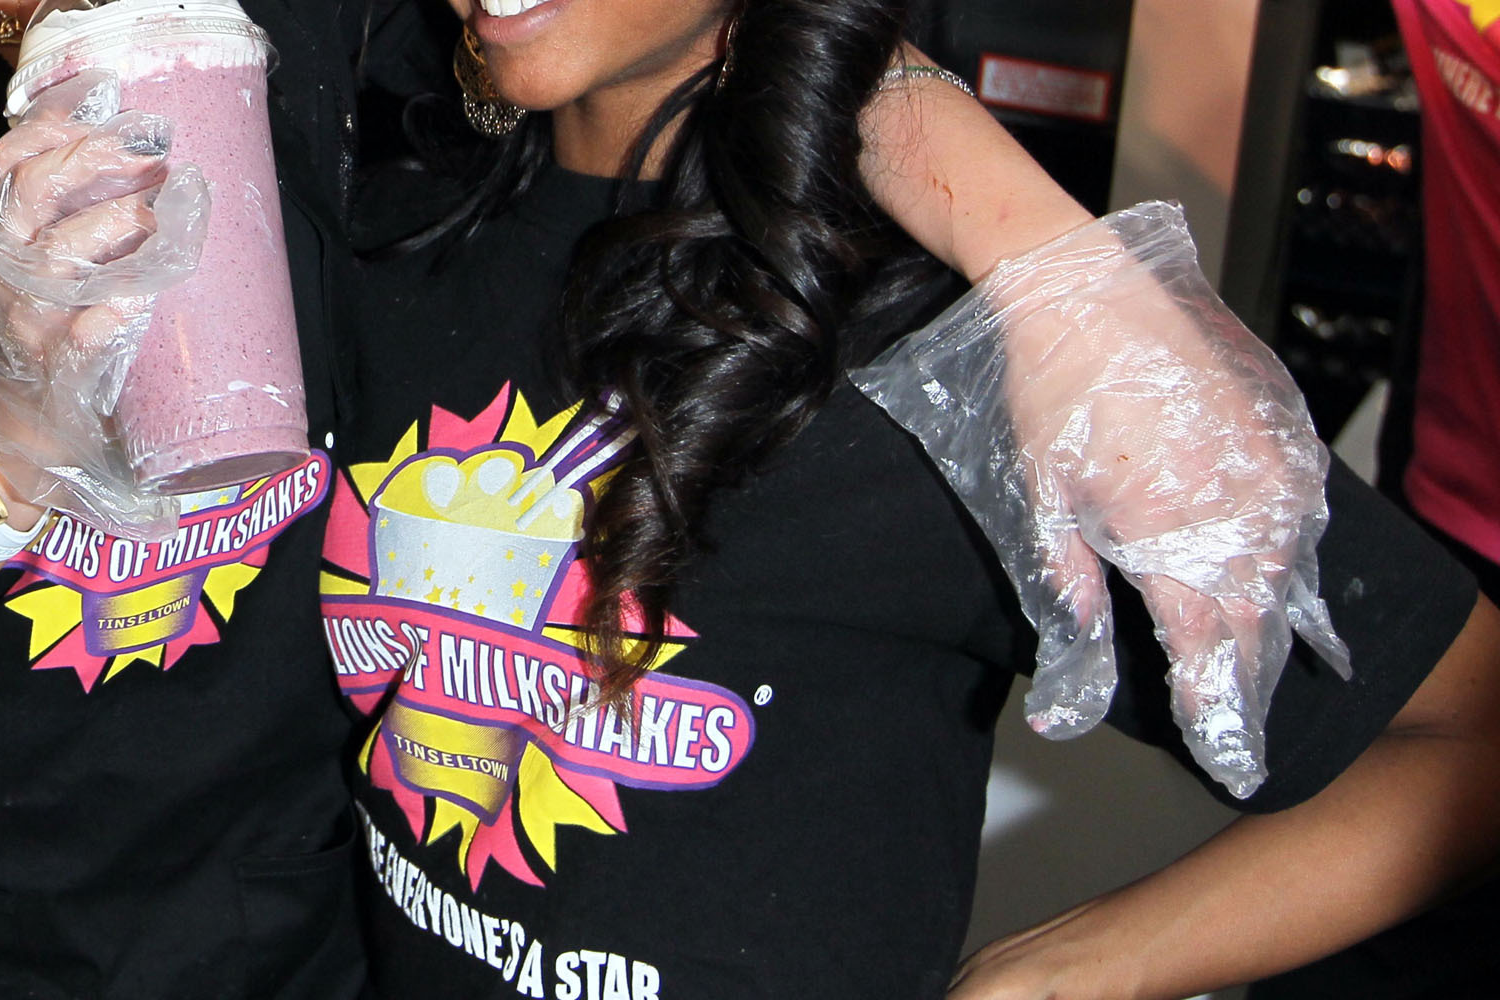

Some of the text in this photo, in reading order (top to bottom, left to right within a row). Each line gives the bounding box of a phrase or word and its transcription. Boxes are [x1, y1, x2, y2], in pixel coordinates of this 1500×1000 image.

[109, 538, 151, 583] OF
[155, 461, 321, 571] MILKSHAKES
[97, 594, 191, 630] TINSELTOWN
[323, 616, 411, 675] LIONS
[400, 622, 430, 690] OF
[439, 633, 736, 773] MILKSHAKES
[393, 733, 510, 783] TINSELTOWN
[384, 841, 526, 983] EVERYONE'S
[516, 938, 545, 999] A
